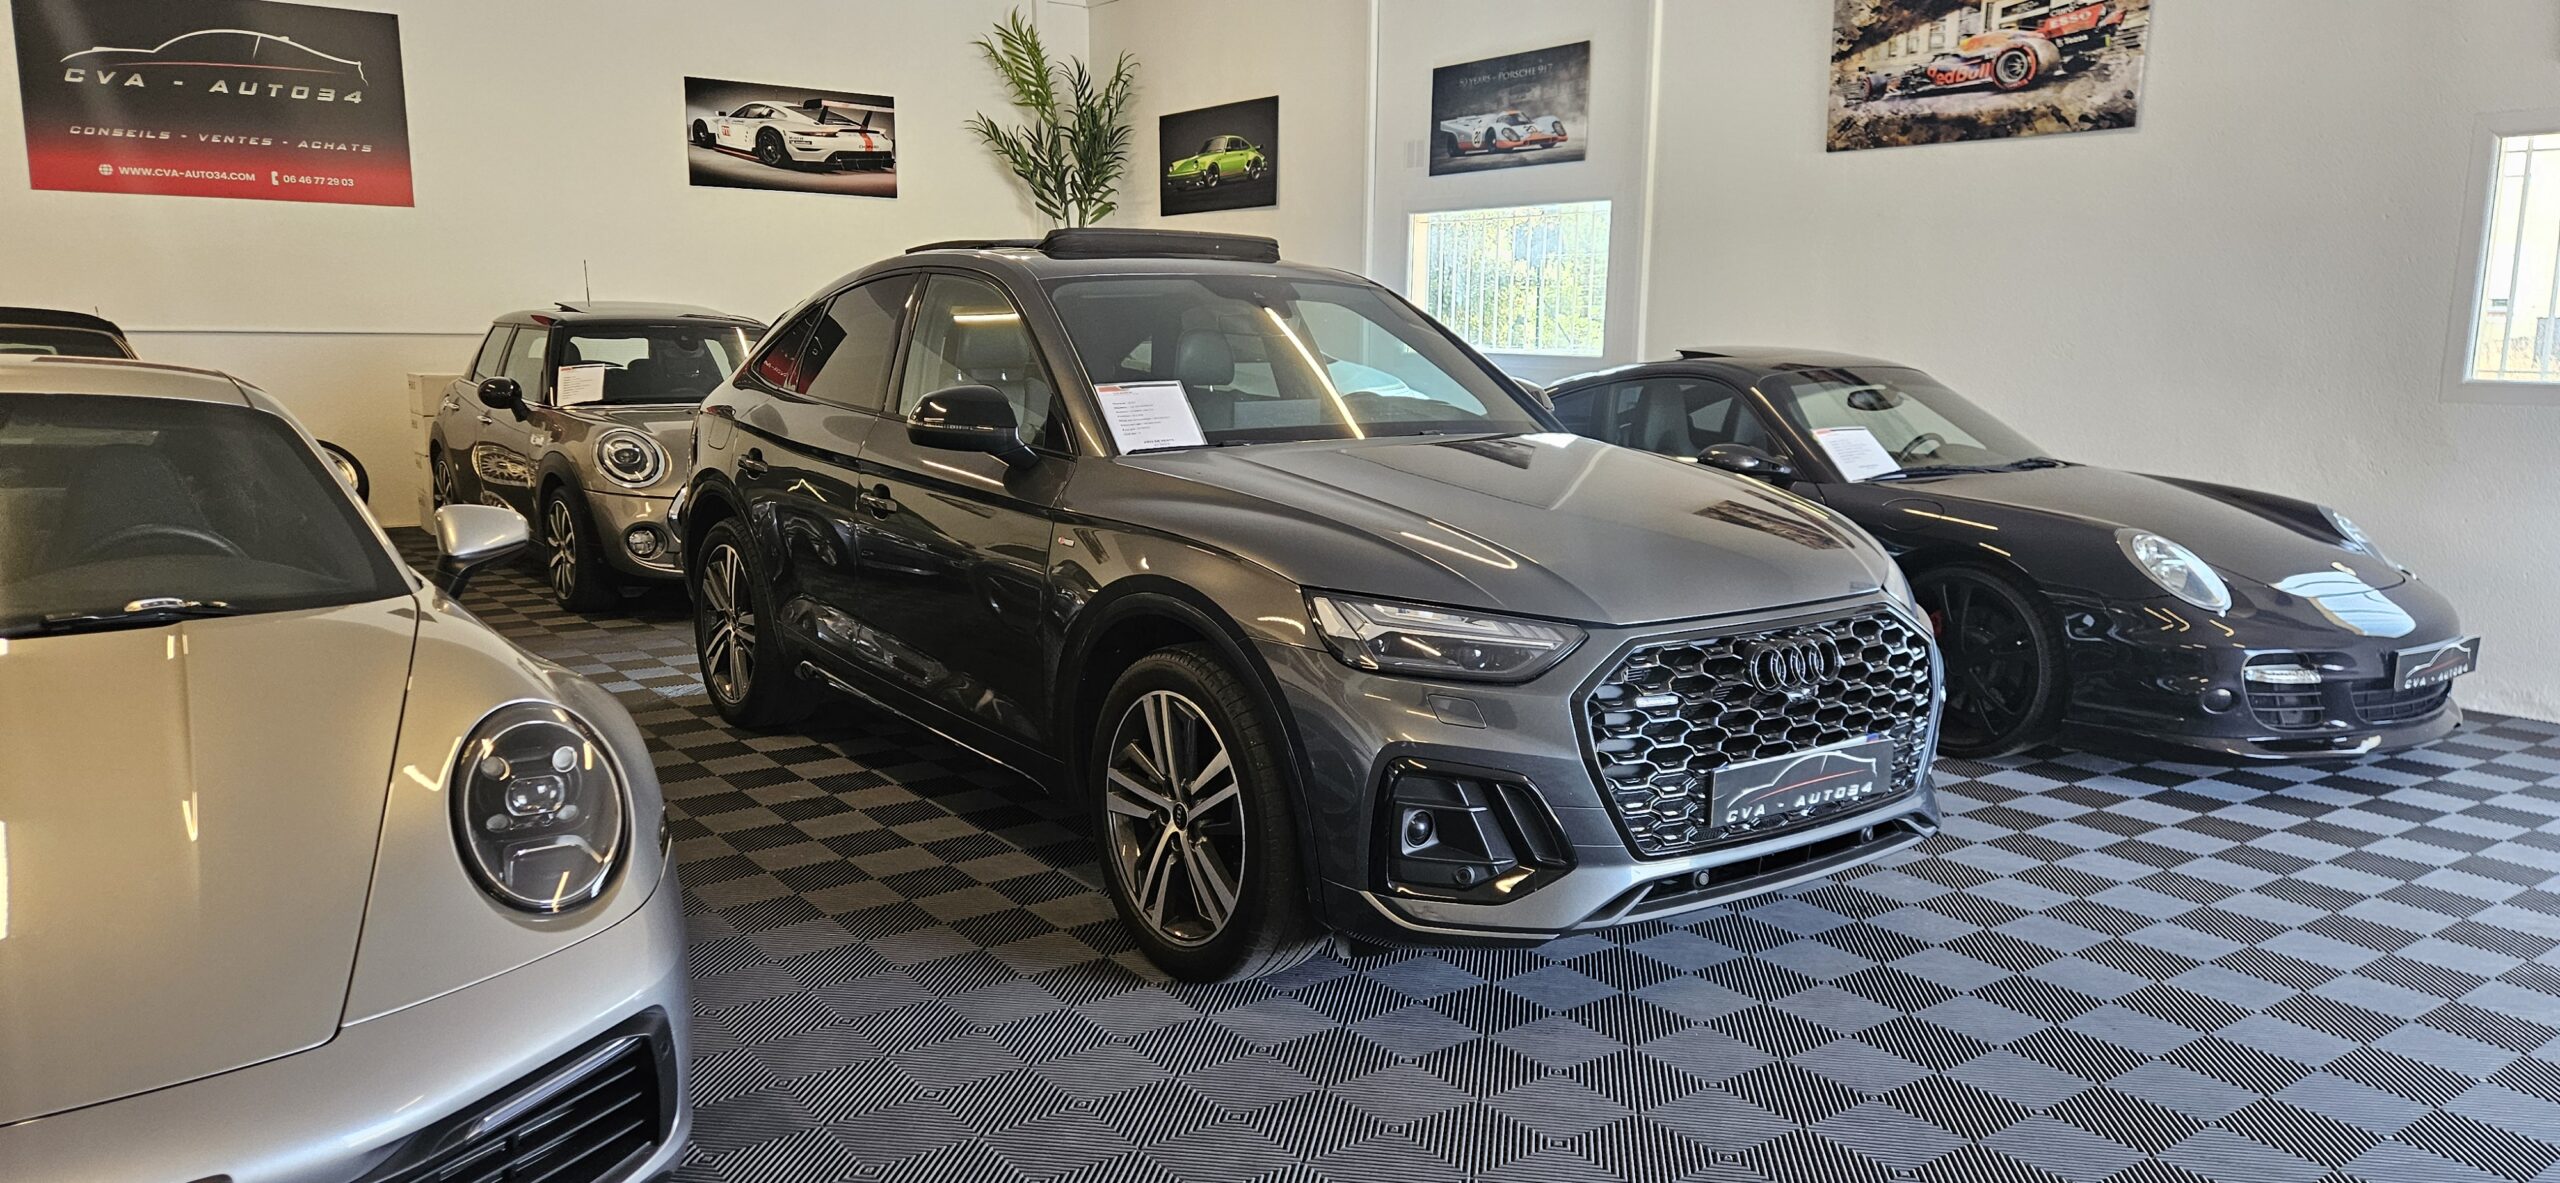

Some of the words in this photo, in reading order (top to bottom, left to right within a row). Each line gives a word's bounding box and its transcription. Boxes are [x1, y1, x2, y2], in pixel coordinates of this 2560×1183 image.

[1498, 67, 1536, 81] PORSCHE
[1537, 63, 1553, 74] 917
[64, 68, 145, 87] CVA
[208, 79, 362, 104] AUTO34
[69, 125, 171, 140] CONSEILS
[198, 132, 273, 146] VENTES
[297, 139, 373, 153] ACHATS
[118, 166, 256, 181] WWW.CVA-AUTO34.COM
[283, 174, 297, 183] 06
[298, 175, 312, 184] 46
[314, 176, 325, 185] 77
[341, 178, 354, 187] 03
[2404, 676, 2427, 689] CVA
[1725, 803, 1766, 823] CVA
[1794, 781, 1874, 808] AUTO34
